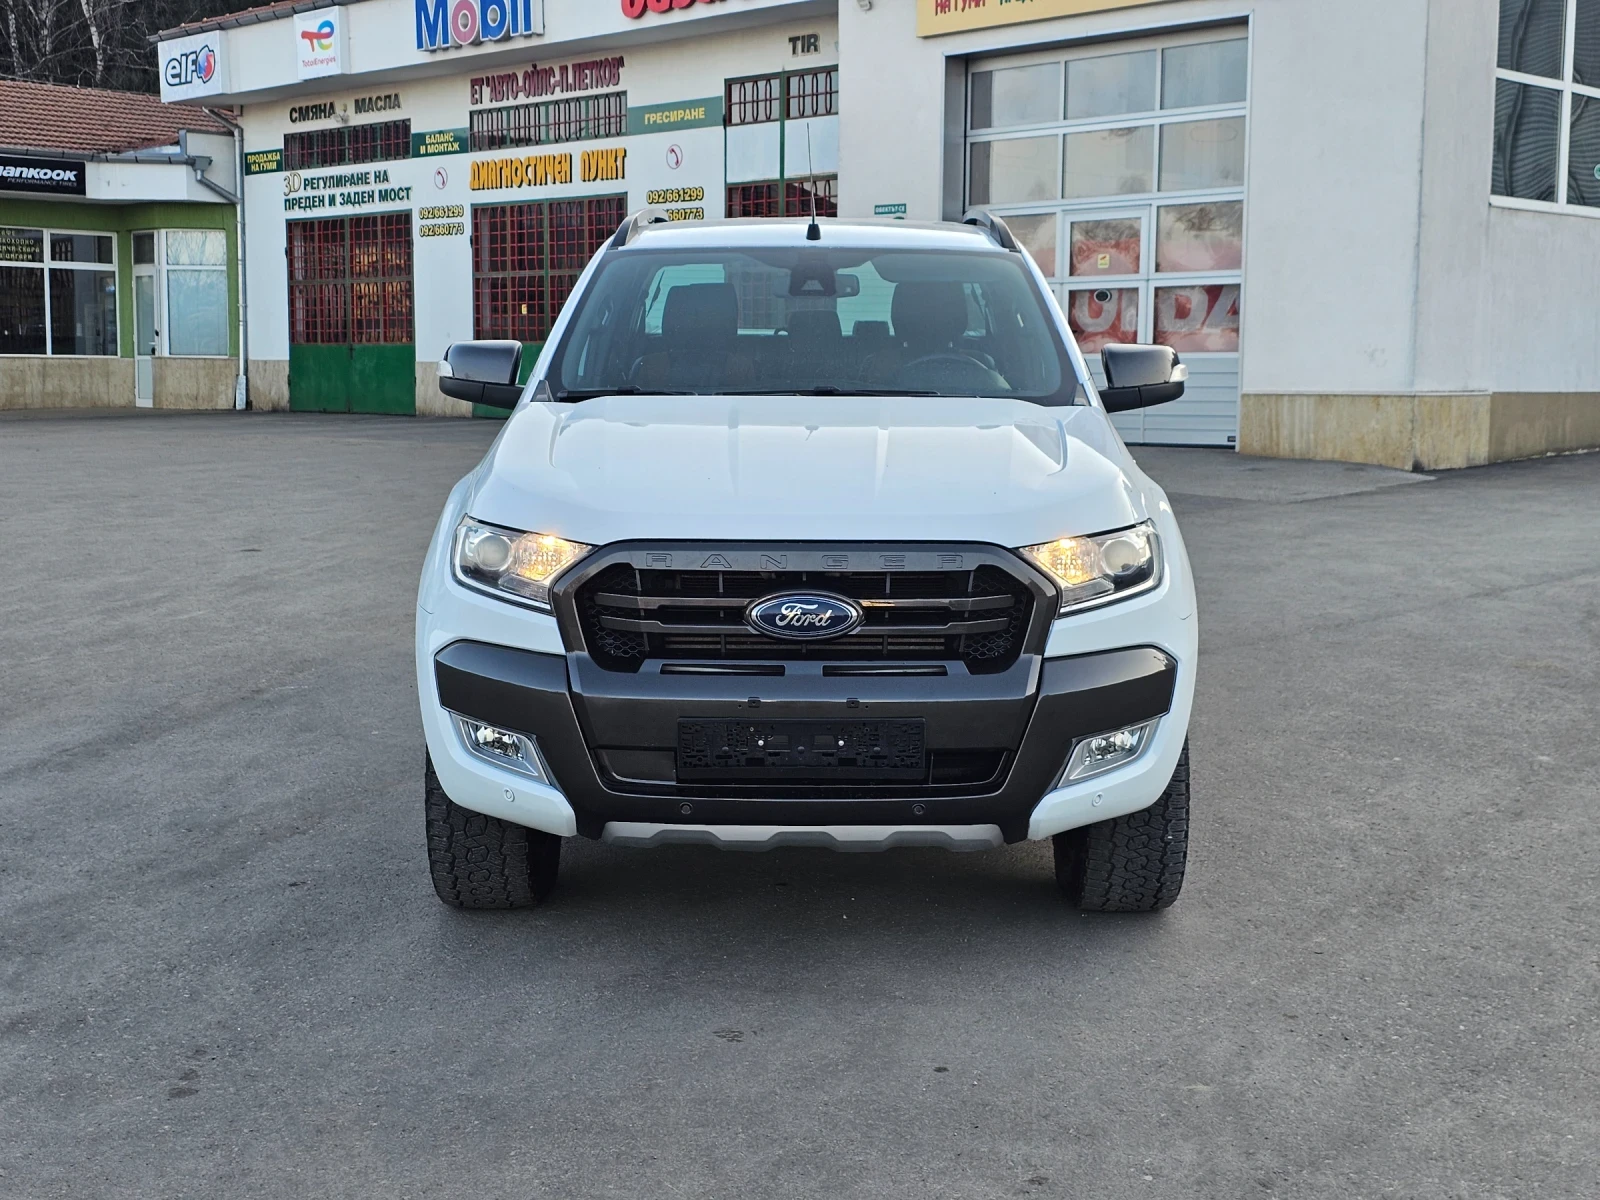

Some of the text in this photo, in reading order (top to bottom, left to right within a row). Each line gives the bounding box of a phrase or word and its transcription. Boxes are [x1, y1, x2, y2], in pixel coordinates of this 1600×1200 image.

[788, 34, 820, 56] TIR
[165, 50, 200, 86] elf
[302, 55, 337, 68] TotalEnergies
[470, 77, 485, 105] ЕТ
[289, 93, 401, 123] СМЯНА МАСЛА
[644, 107, 705, 125] ГРЕСИРАНЕ
[425, 132, 454, 144] БАЛАНС
[420, 142, 460, 154] И МОНТАЖ
[247, 152, 281, 164] ПРОДАЖБА
[251, 160, 277, 172] НА ГУМИ
[0, 165, 78, 181] ankook
[470, 147, 627, 191] ДИАГНОСТИЧЕН ПУНКТ
[7, 177, 57, 186] PERFORMANCE
[283, 169, 390, 196] 3D РЕГУЛИРАНЕ НА
[284, 186, 412, 211] ПРЕДЕН И ЗАДЕН МОСТ
[646, 186, 705, 204] 092/661299
[419, 204, 465, 220] 092/661299
[419, 222, 465, 237] 092/660773
[645, 553, 964, 570] RANGER
[775, 602, 835, 627] Ford
